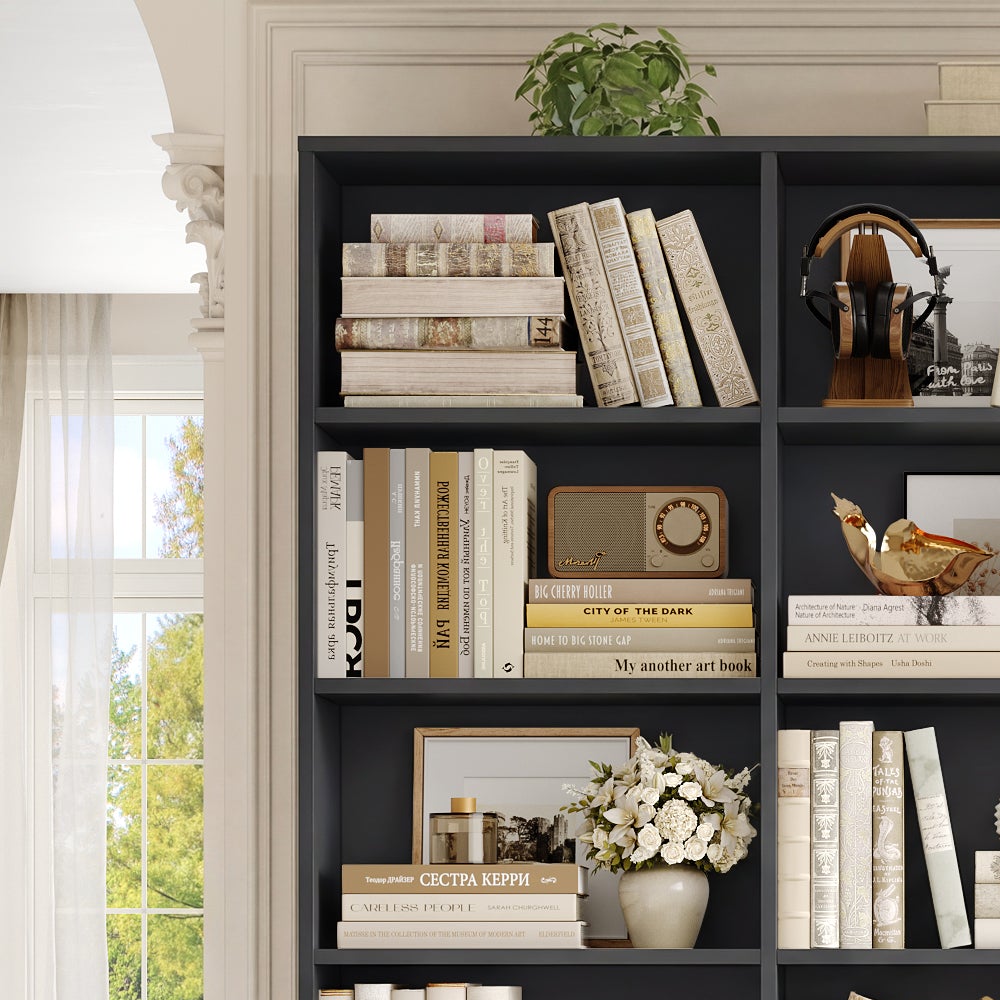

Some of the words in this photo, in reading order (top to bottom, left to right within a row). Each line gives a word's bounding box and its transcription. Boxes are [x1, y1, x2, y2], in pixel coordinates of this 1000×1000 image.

[533, 317, 553, 344] 144
[927, 364, 960, 376] From
[964, 362, 993, 372] Paris
[927, 375, 957, 388] with
[960, 375, 985, 386] love
[534, 584, 549, 599] BIG
[551, 584, 581, 599] CHERRY
[583, 584, 613, 599] HOLLER
[583, 607, 611, 616] CITY
[613, 607, 629, 616] OF
[634, 607, 658, 616] THE
[661, 607, 694, 616] DARK
[795, 603, 830, 611] Architecture
[837, 603, 855, 611] Nature
[862, 603, 881, 611] Diana
[882, 603, 904, 613] Agrest
[795, 611, 815, 619] Nature
[822, 611, 855, 619] Architecture
[531, 635, 555, 646] HOME
[558, 635, 568, 646] TO
[571, 635, 586, 646] BIG
[588, 635, 613, 646] STONE
[615, 635, 632, 646] GAP
[805, 633, 838, 643] ANNIE
[842, 633, 894, 643] LEIBOITZ
[898, 633, 911, 643] AT
[915, 633, 947, 643] WORK
[615, 658, 636, 675] My
[640, 658, 692, 672] another
[696, 660, 715, 672] art
[719, 658, 752, 672] book
[807, 660, 838, 670] Creating
[840, 660, 856, 668] with
[858, 660, 883, 670] Shapes
[891, 660, 909, 668] Usha
[911, 660, 932, 668] Doshi
[873, 766, 900, 777] TALES
[872, 787, 903, 799] PUNJAB
[365, 876, 387, 885] Теодор
[388, 875, 414, 884] ДРАЙЗЕР
[420, 873, 478, 887] СЕСТРА
[482, 873, 530, 887] КЕРРИ
[350, 903, 418, 912] CARELESS
[424, 903, 476, 912] PEOPLE
